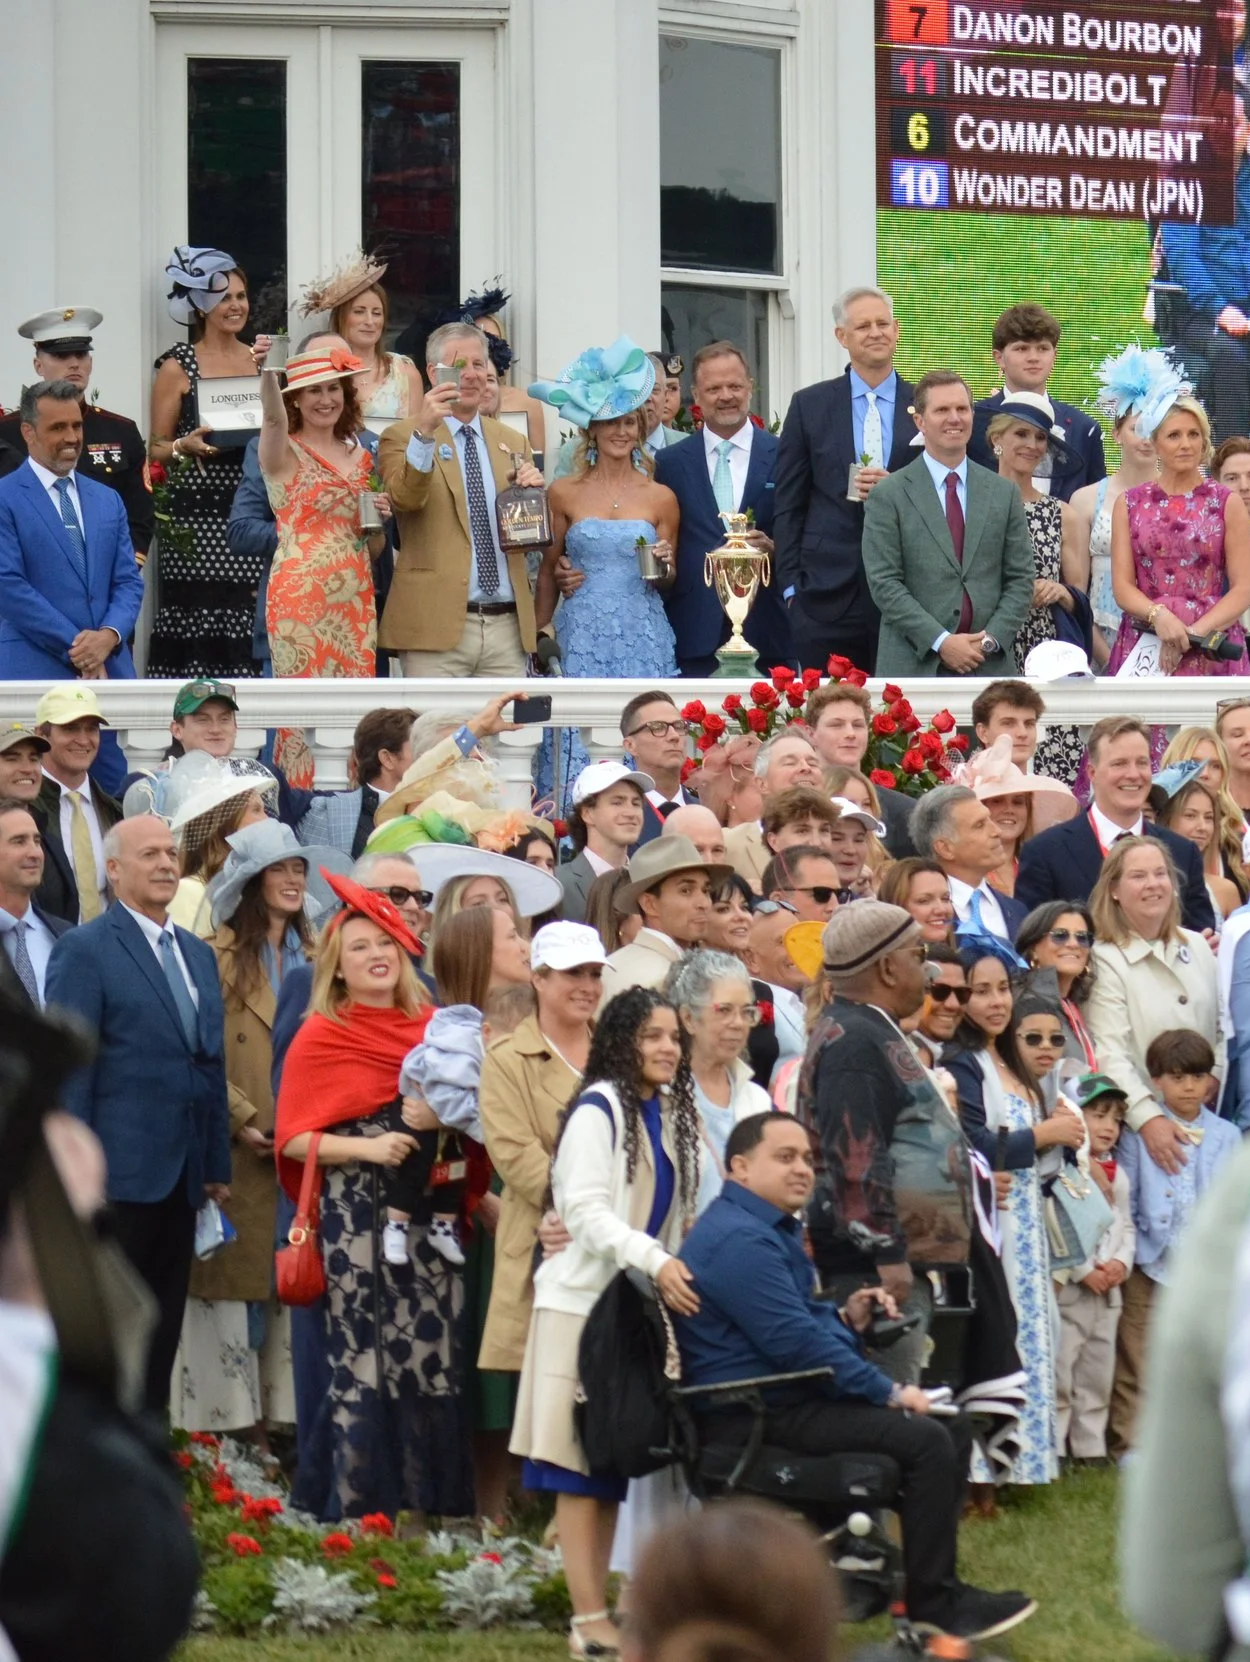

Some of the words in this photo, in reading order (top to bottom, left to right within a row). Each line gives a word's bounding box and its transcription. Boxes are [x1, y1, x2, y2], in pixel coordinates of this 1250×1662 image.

[909, 6, 927, 37] 7
[899, 58, 937, 94] 11
[907, 113, 929, 150] 6
[899, 167, 940, 205] 10
[211, 393, 261, 404] LONGINES
